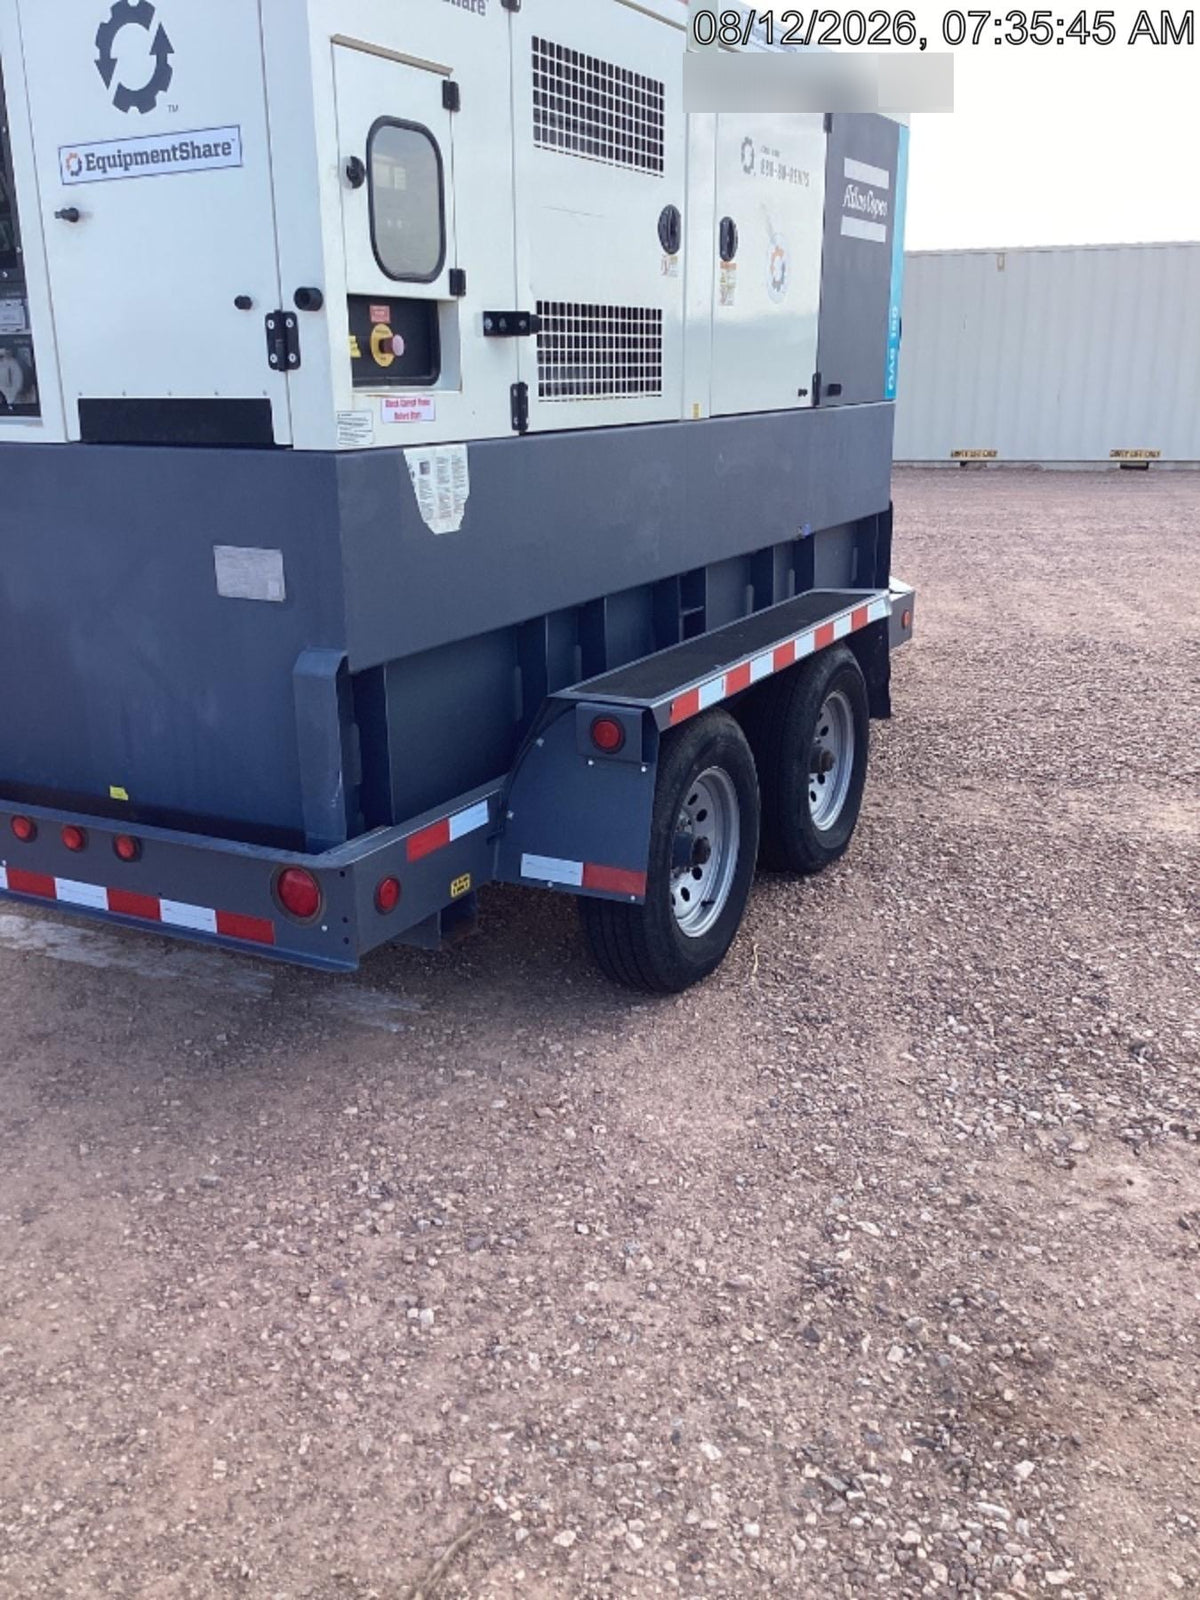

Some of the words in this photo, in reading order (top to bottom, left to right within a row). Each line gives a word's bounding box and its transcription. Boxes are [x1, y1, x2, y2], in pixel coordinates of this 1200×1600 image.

[85, 140, 232, 174] EquipmentShare
[842, 184, 867, 213] Atlas
[866, 189, 888, 219] Copco
